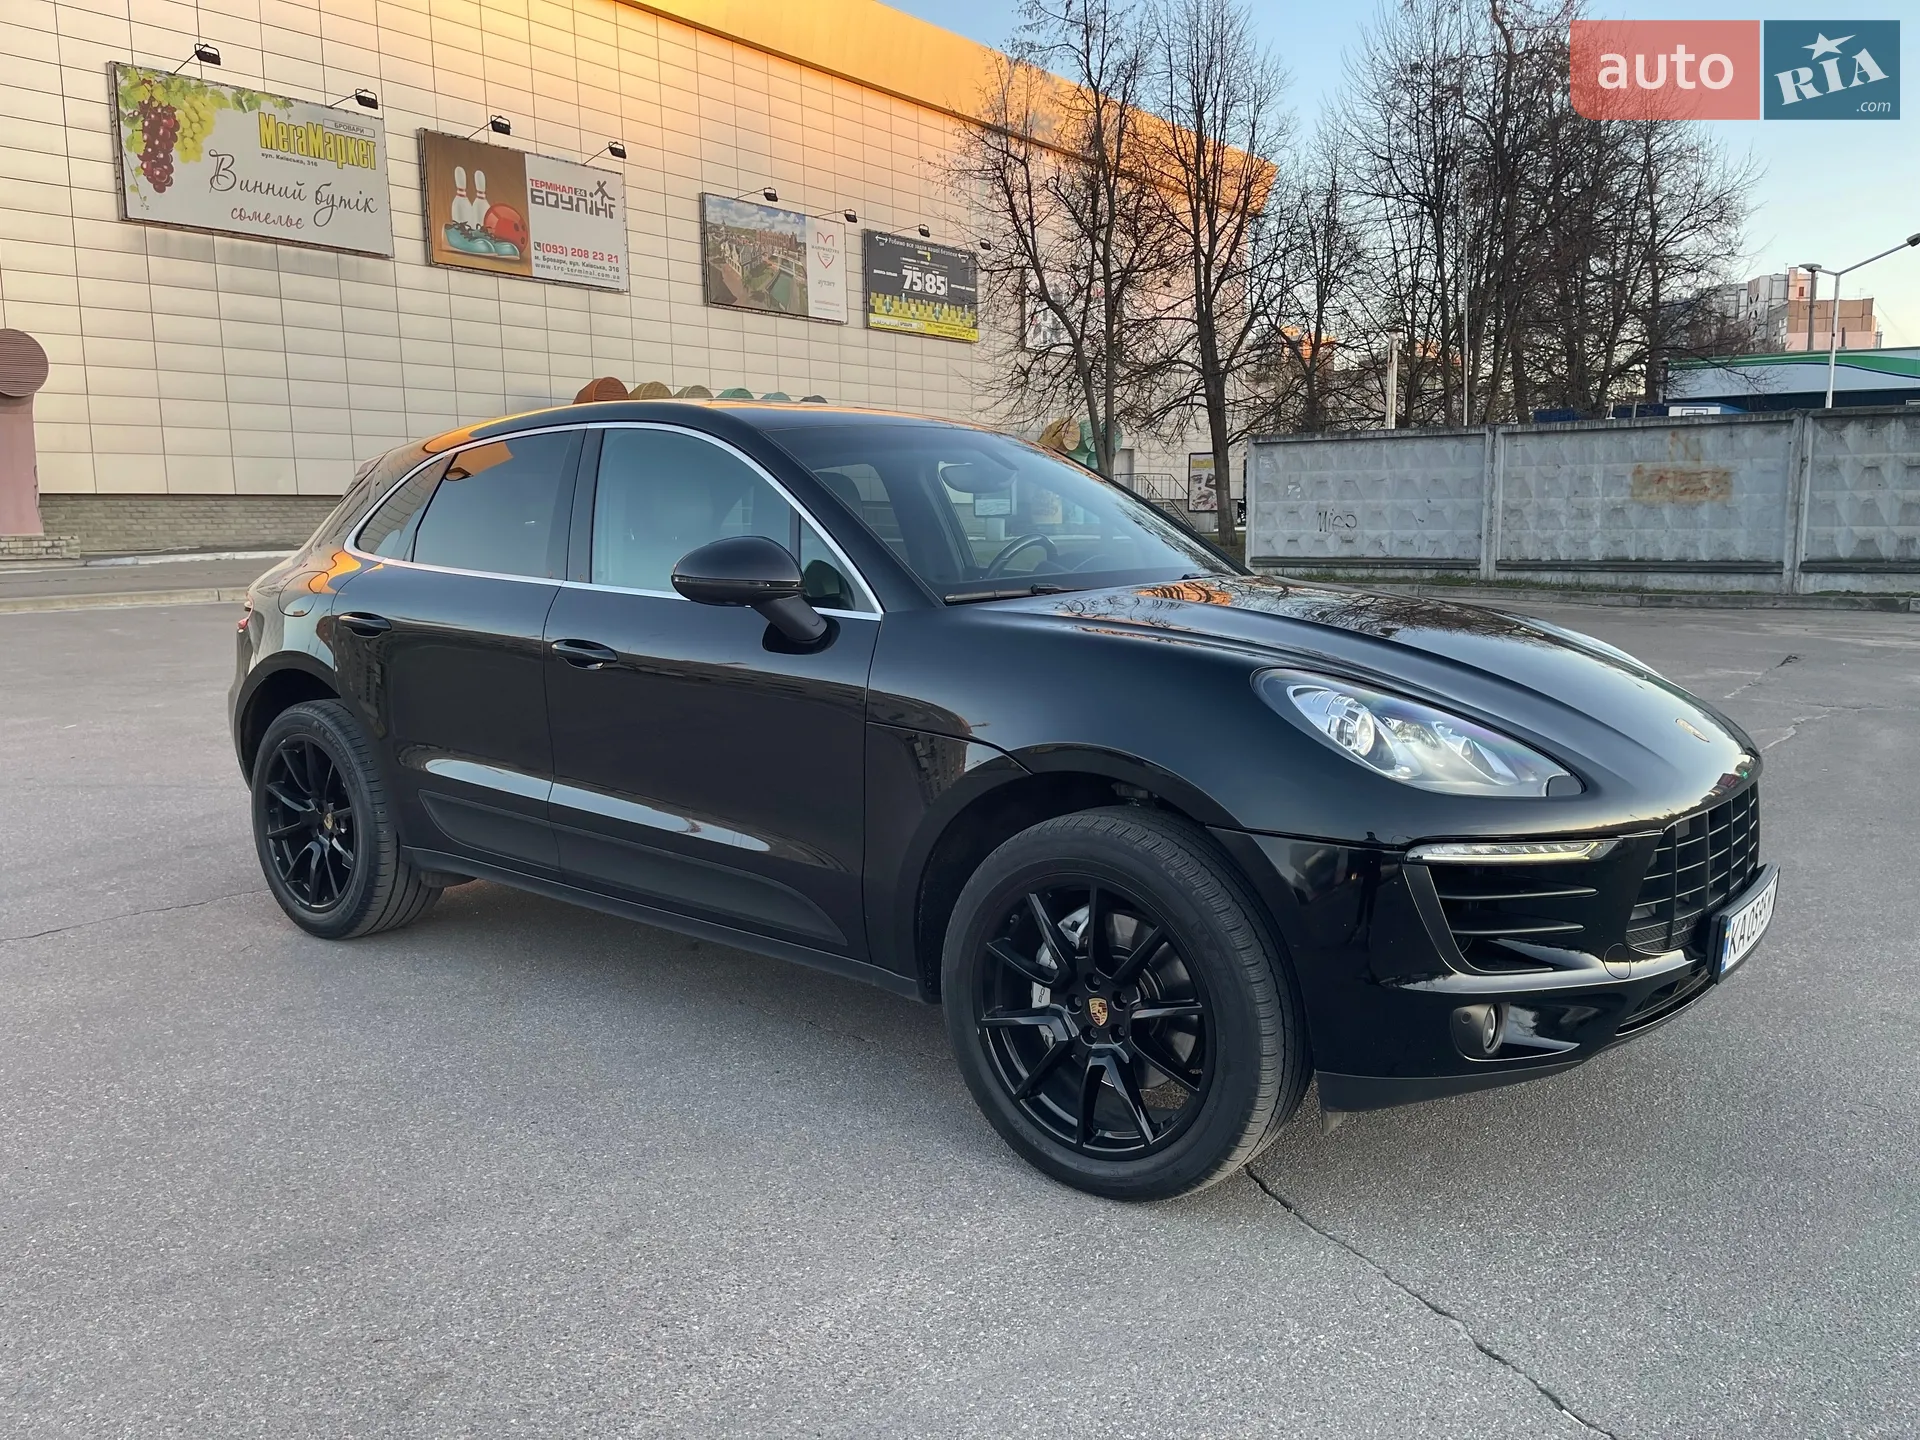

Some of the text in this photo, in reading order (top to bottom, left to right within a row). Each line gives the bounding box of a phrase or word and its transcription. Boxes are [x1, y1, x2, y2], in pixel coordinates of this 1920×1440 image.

[258, 111, 376, 170] МегаМаркет
[334, 122, 365, 134] БРОВАРИ
[209, 149, 378, 227] Винний бутік
[529, 178, 586, 197] ТЕРМІНАЛ 24
[530, 187, 616, 219] БОУЛІНГ
[541, 242, 619, 264] (093) 208 23 21
[902, 268, 922, 291] 75
[925, 273, 946, 296] 85
